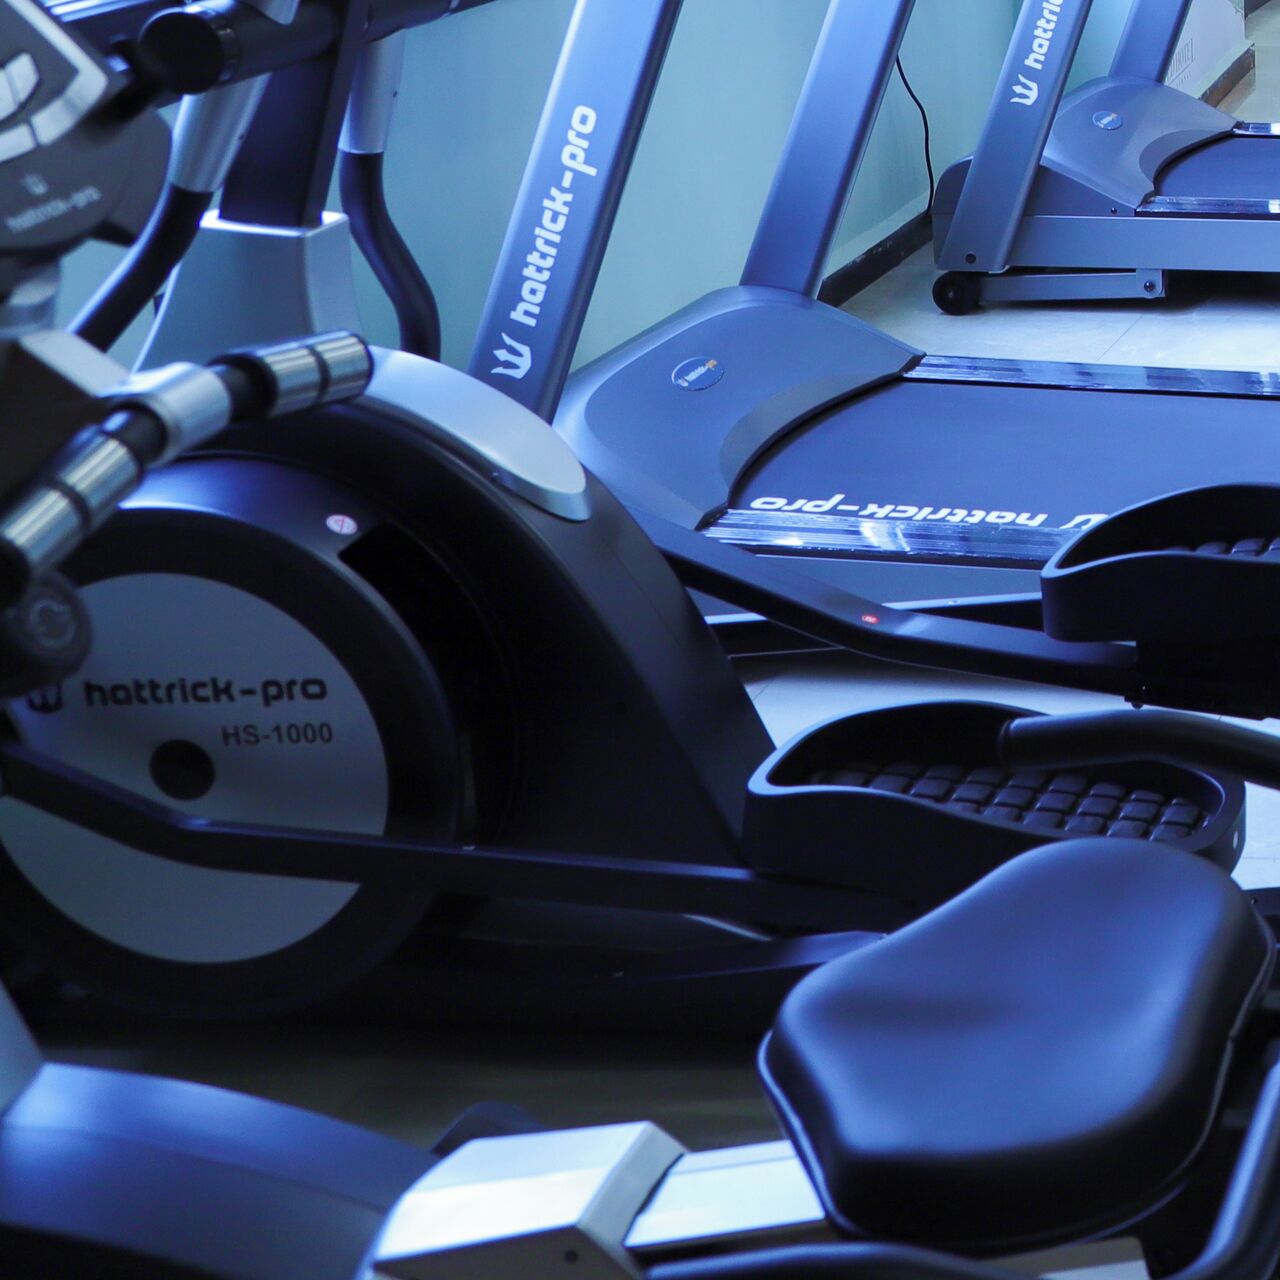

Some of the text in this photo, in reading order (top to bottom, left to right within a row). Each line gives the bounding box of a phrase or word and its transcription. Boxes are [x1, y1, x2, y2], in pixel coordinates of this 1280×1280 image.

[510, 105, 598, 327] hattrick-pro
[84, 677, 328, 708] hattrick-pro
[222, 723, 333, 747] HS-1000
